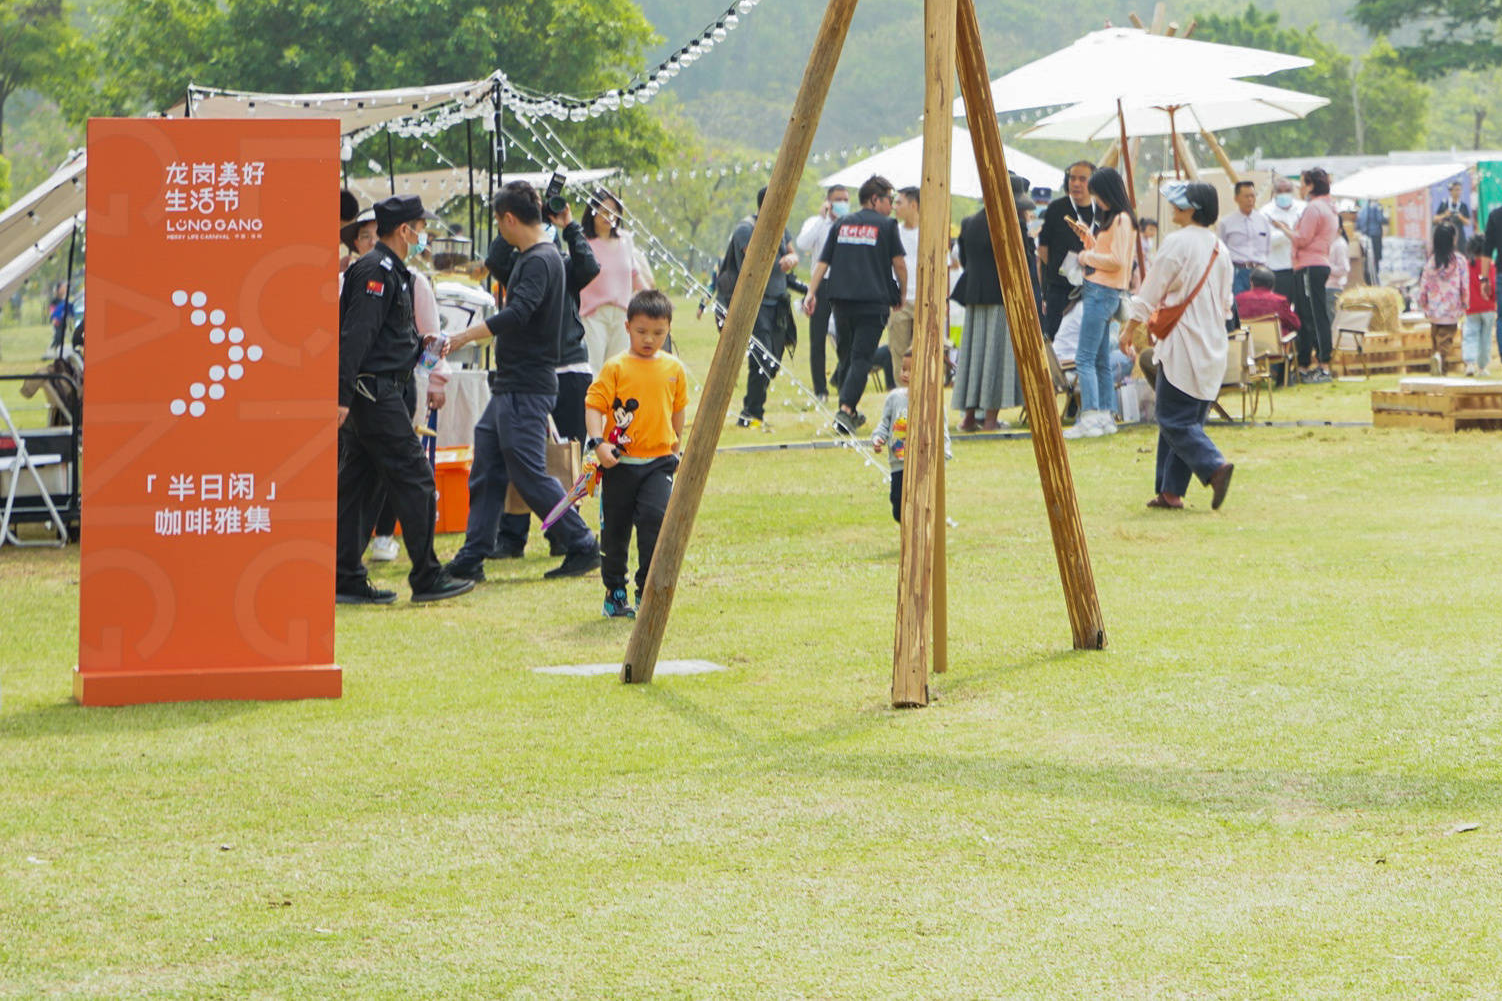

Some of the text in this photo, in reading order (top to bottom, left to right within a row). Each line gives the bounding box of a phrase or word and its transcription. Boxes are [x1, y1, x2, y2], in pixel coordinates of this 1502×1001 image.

[165, 161, 265, 187] 龙岗美好
[164, 187, 239, 215] 生活节
[155, 505, 271, 536] 咖啡雅集
